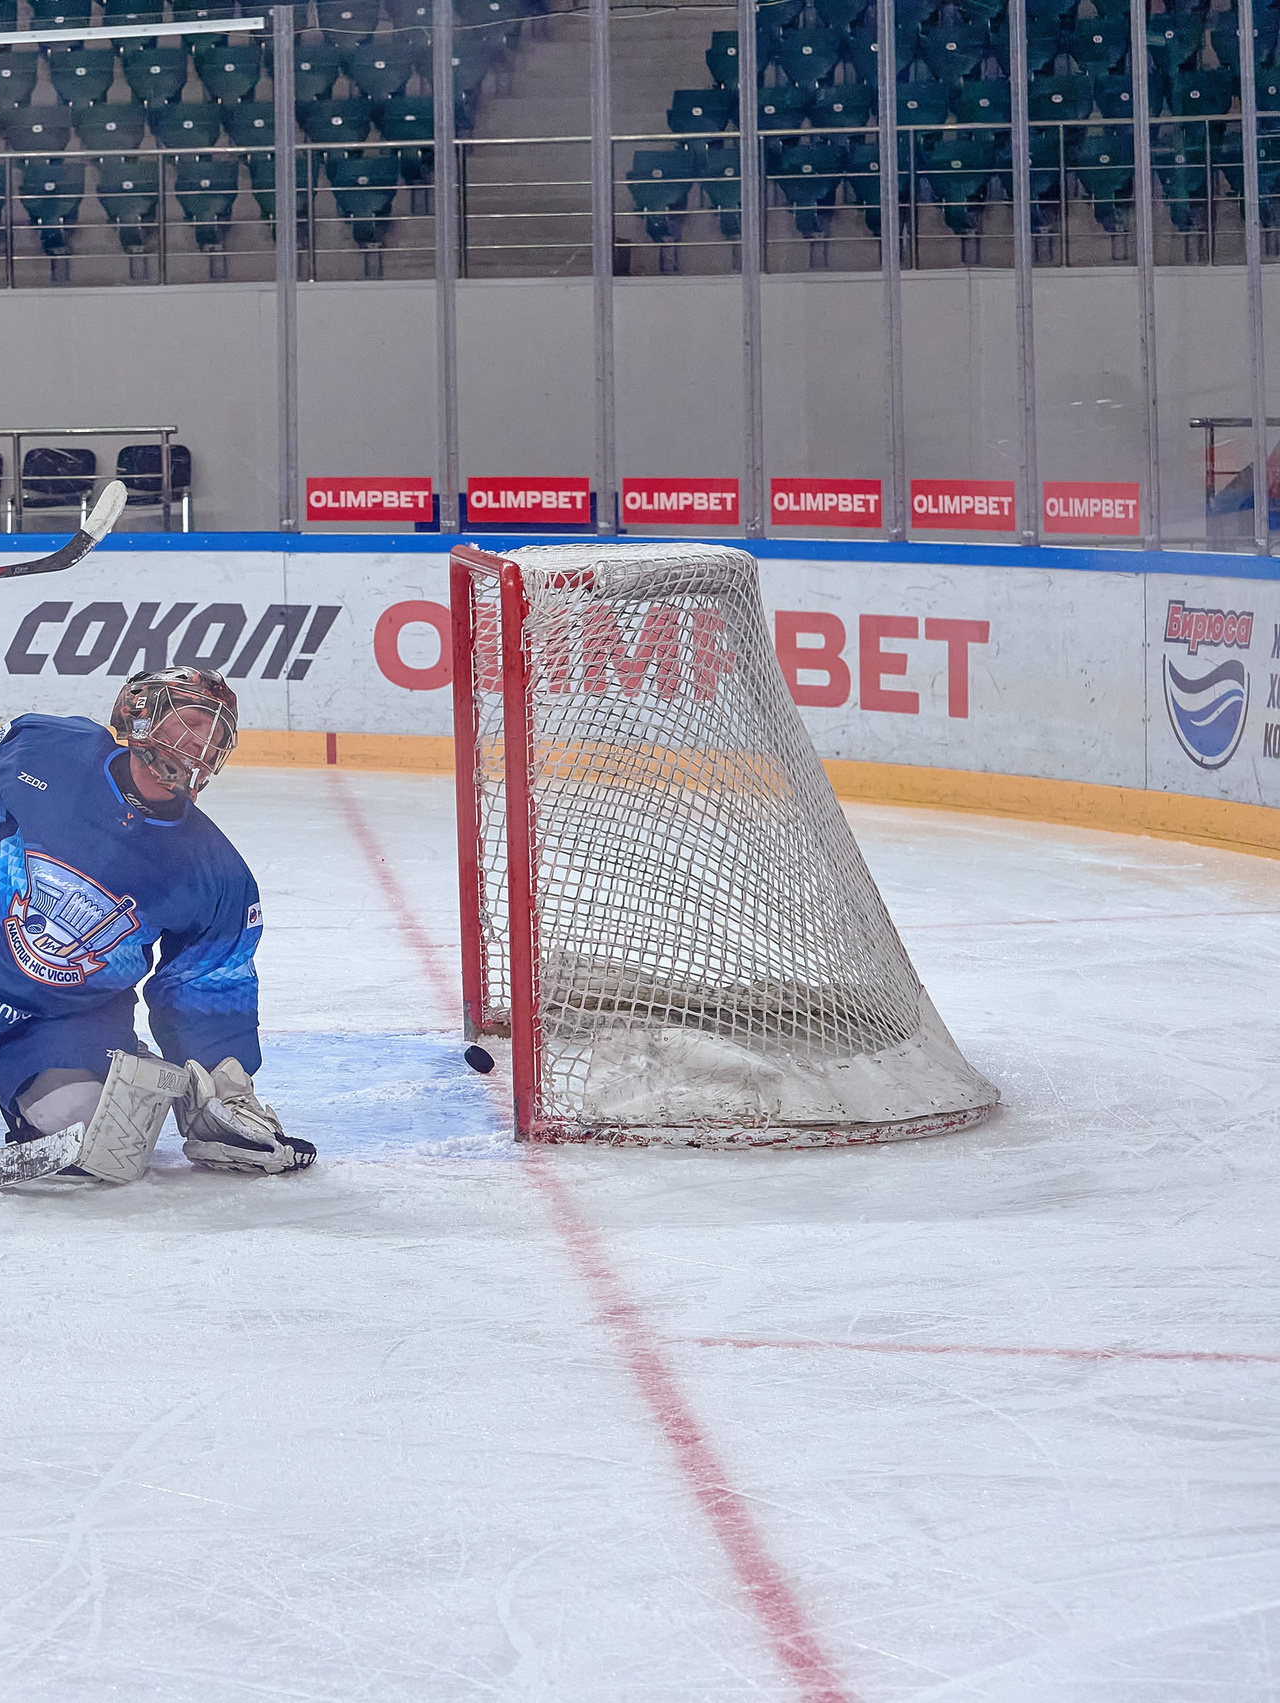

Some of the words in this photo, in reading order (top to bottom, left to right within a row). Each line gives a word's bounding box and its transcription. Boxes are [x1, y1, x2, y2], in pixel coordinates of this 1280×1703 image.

[309, 490, 429, 509] OLIMPBET
[470, 490, 587, 510] OLIMPBET
[624, 491, 737, 511] OLIMPBET
[773, 492, 879, 514] OLIMPBET
[913, 494, 1013, 516] OLIMPBET
[1045, 497, 1137, 520] OLIMPBET
[1163, 599, 1254, 656] Бирюса
[4, 601, 343, 680] СОКОЛ!
[17, 771, 49, 791] ZEDO
[7, 920, 30, 966] NASCITUR
[28, 960, 45, 977] HIC
[47, 969, 80, 983] VIGOR
